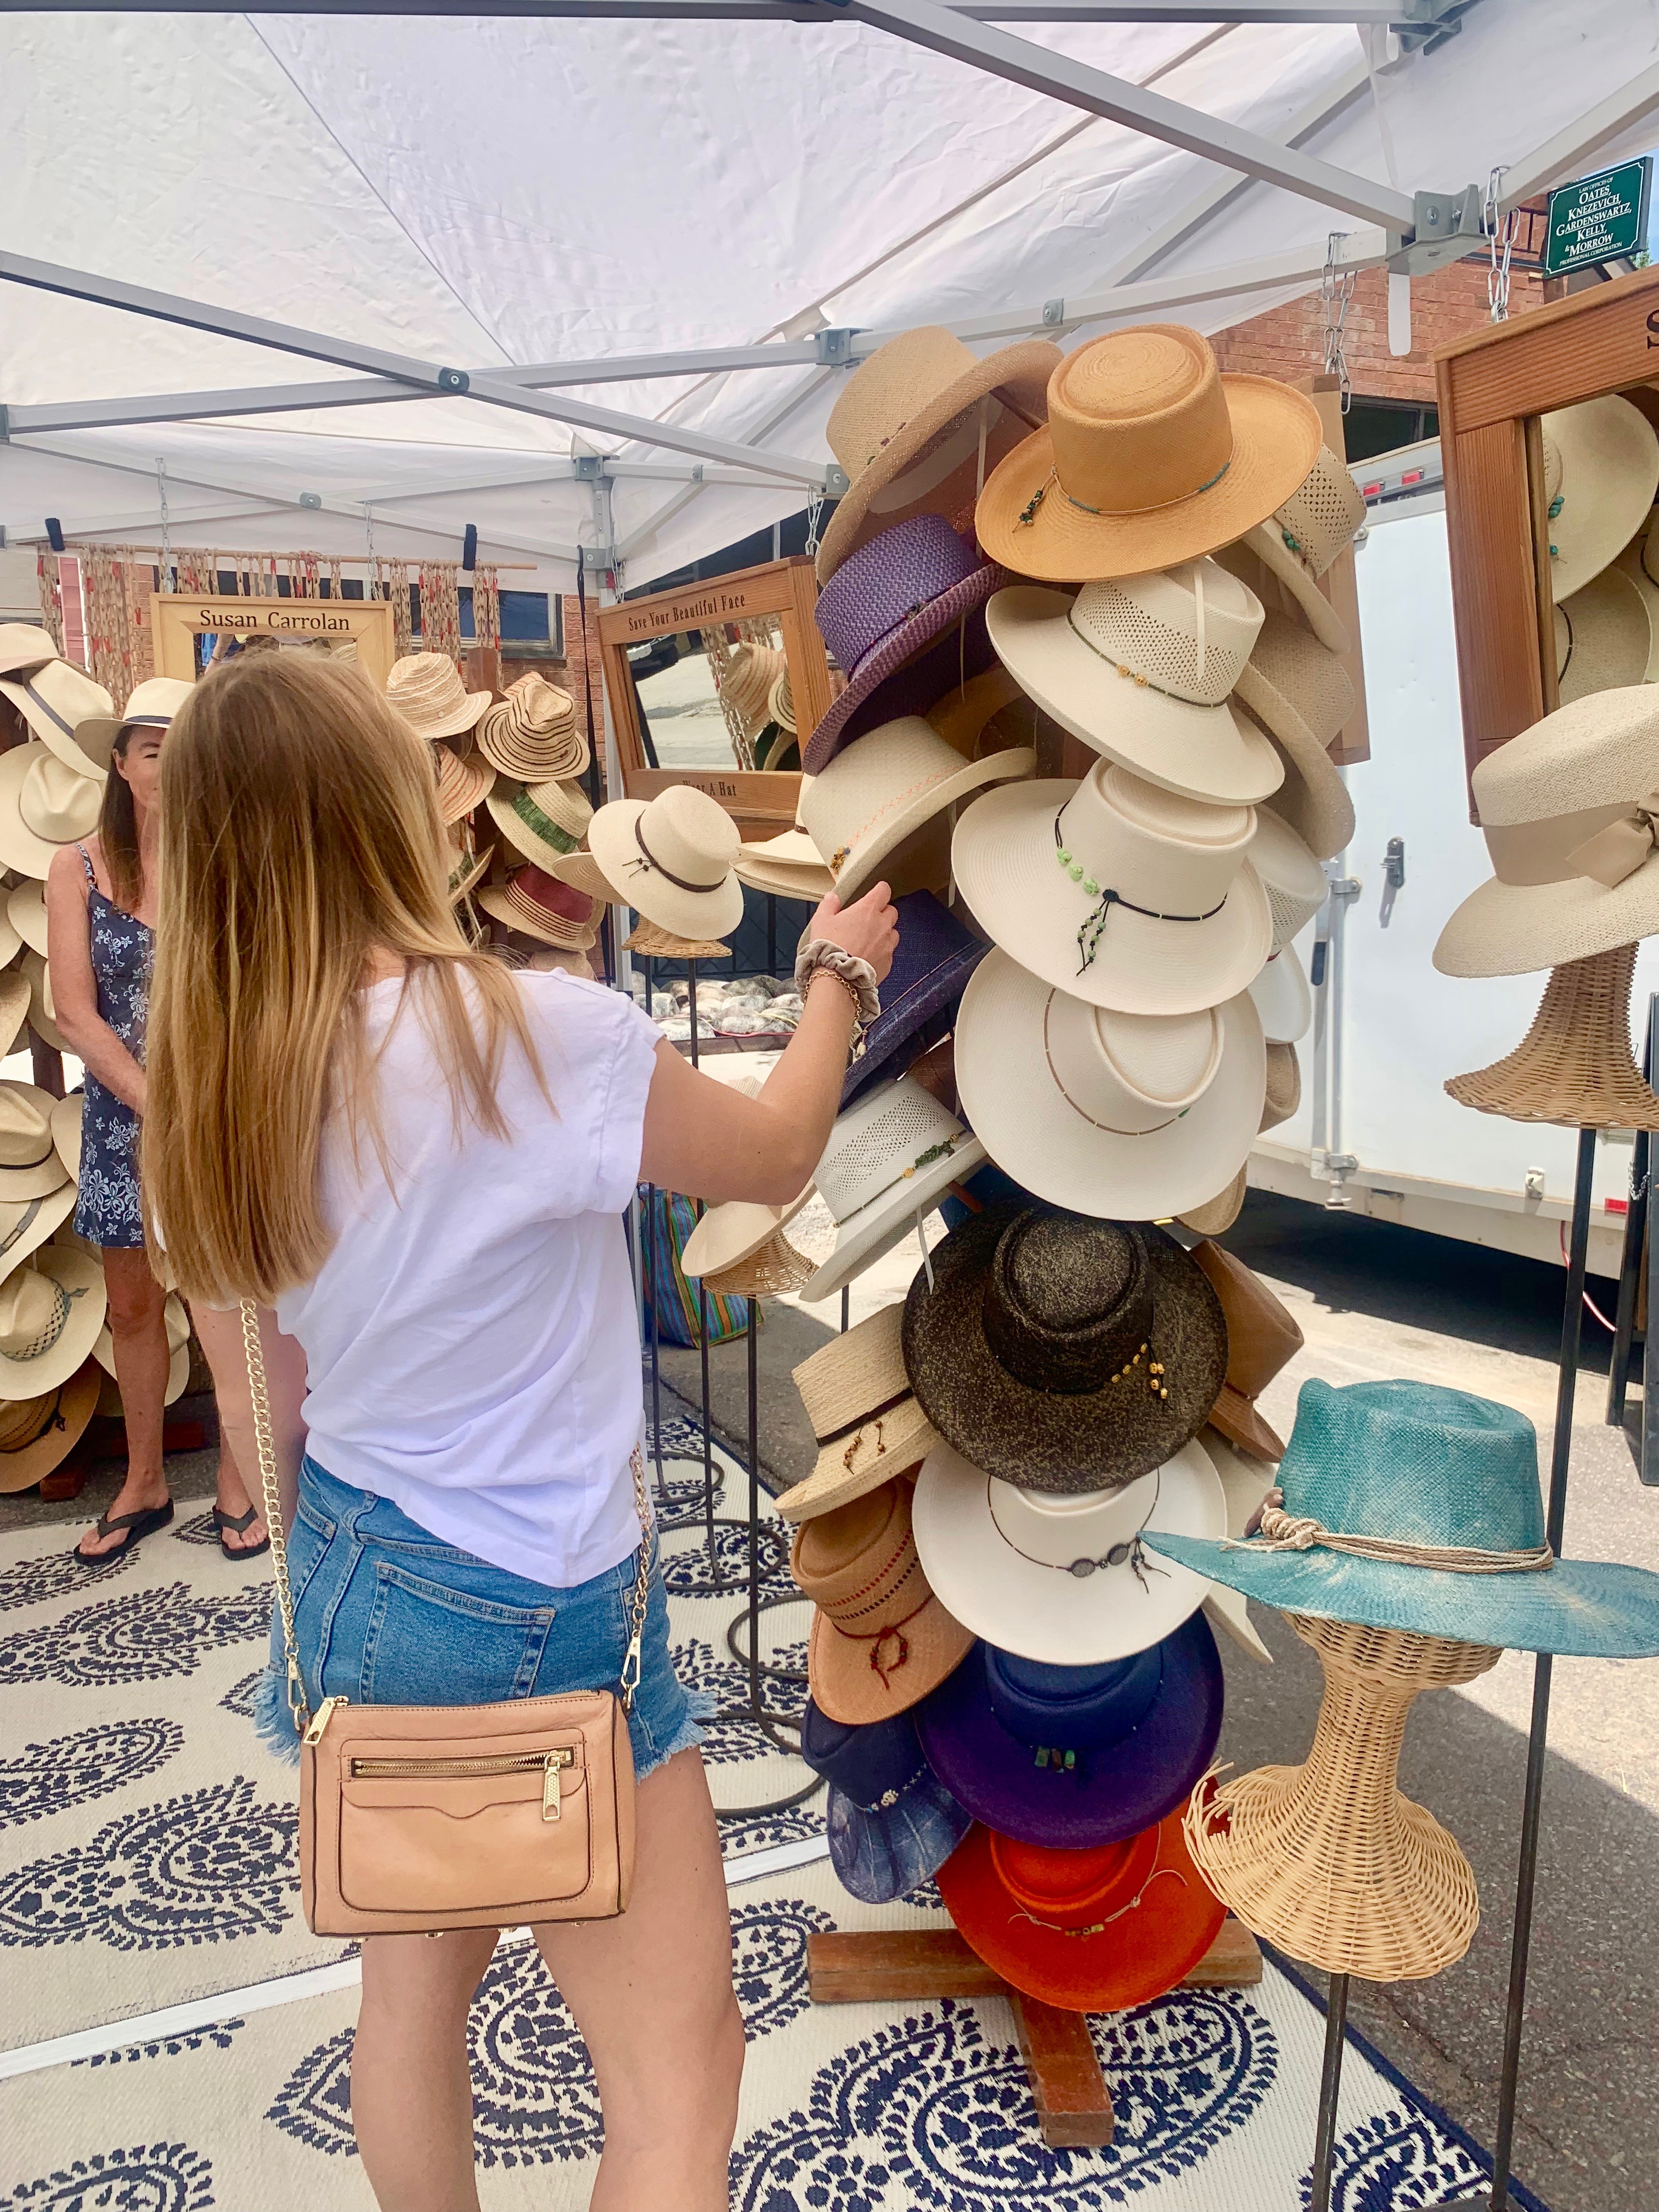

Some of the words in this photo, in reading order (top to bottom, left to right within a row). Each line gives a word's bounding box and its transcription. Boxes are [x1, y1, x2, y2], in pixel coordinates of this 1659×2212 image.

[1589, 179, 1607, 189] OFFICES
[1579, 185, 1612, 204] OATES,
[1568, 193, 1621, 221] KNEZEVICH,
[1556, 202, 1632, 236] GARDENSWARTZ,
[1577, 223, 1607, 242] KELLY,
[1560, 252, 1590, 266] PROFESSIONAL
[1590, 241, 1622, 255] CORPORATION
[200, 610, 257, 628] Susan
[268, 611, 350, 630] Carrolan
[629, 617, 647, 631] Save
[649, 612, 669, 627] Your
[673, 597, 717, 622] Beautiful
[721, 595, 745, 610] Face
[710, 782, 716, 795] A
[718, 781, 736, 796] Hat
